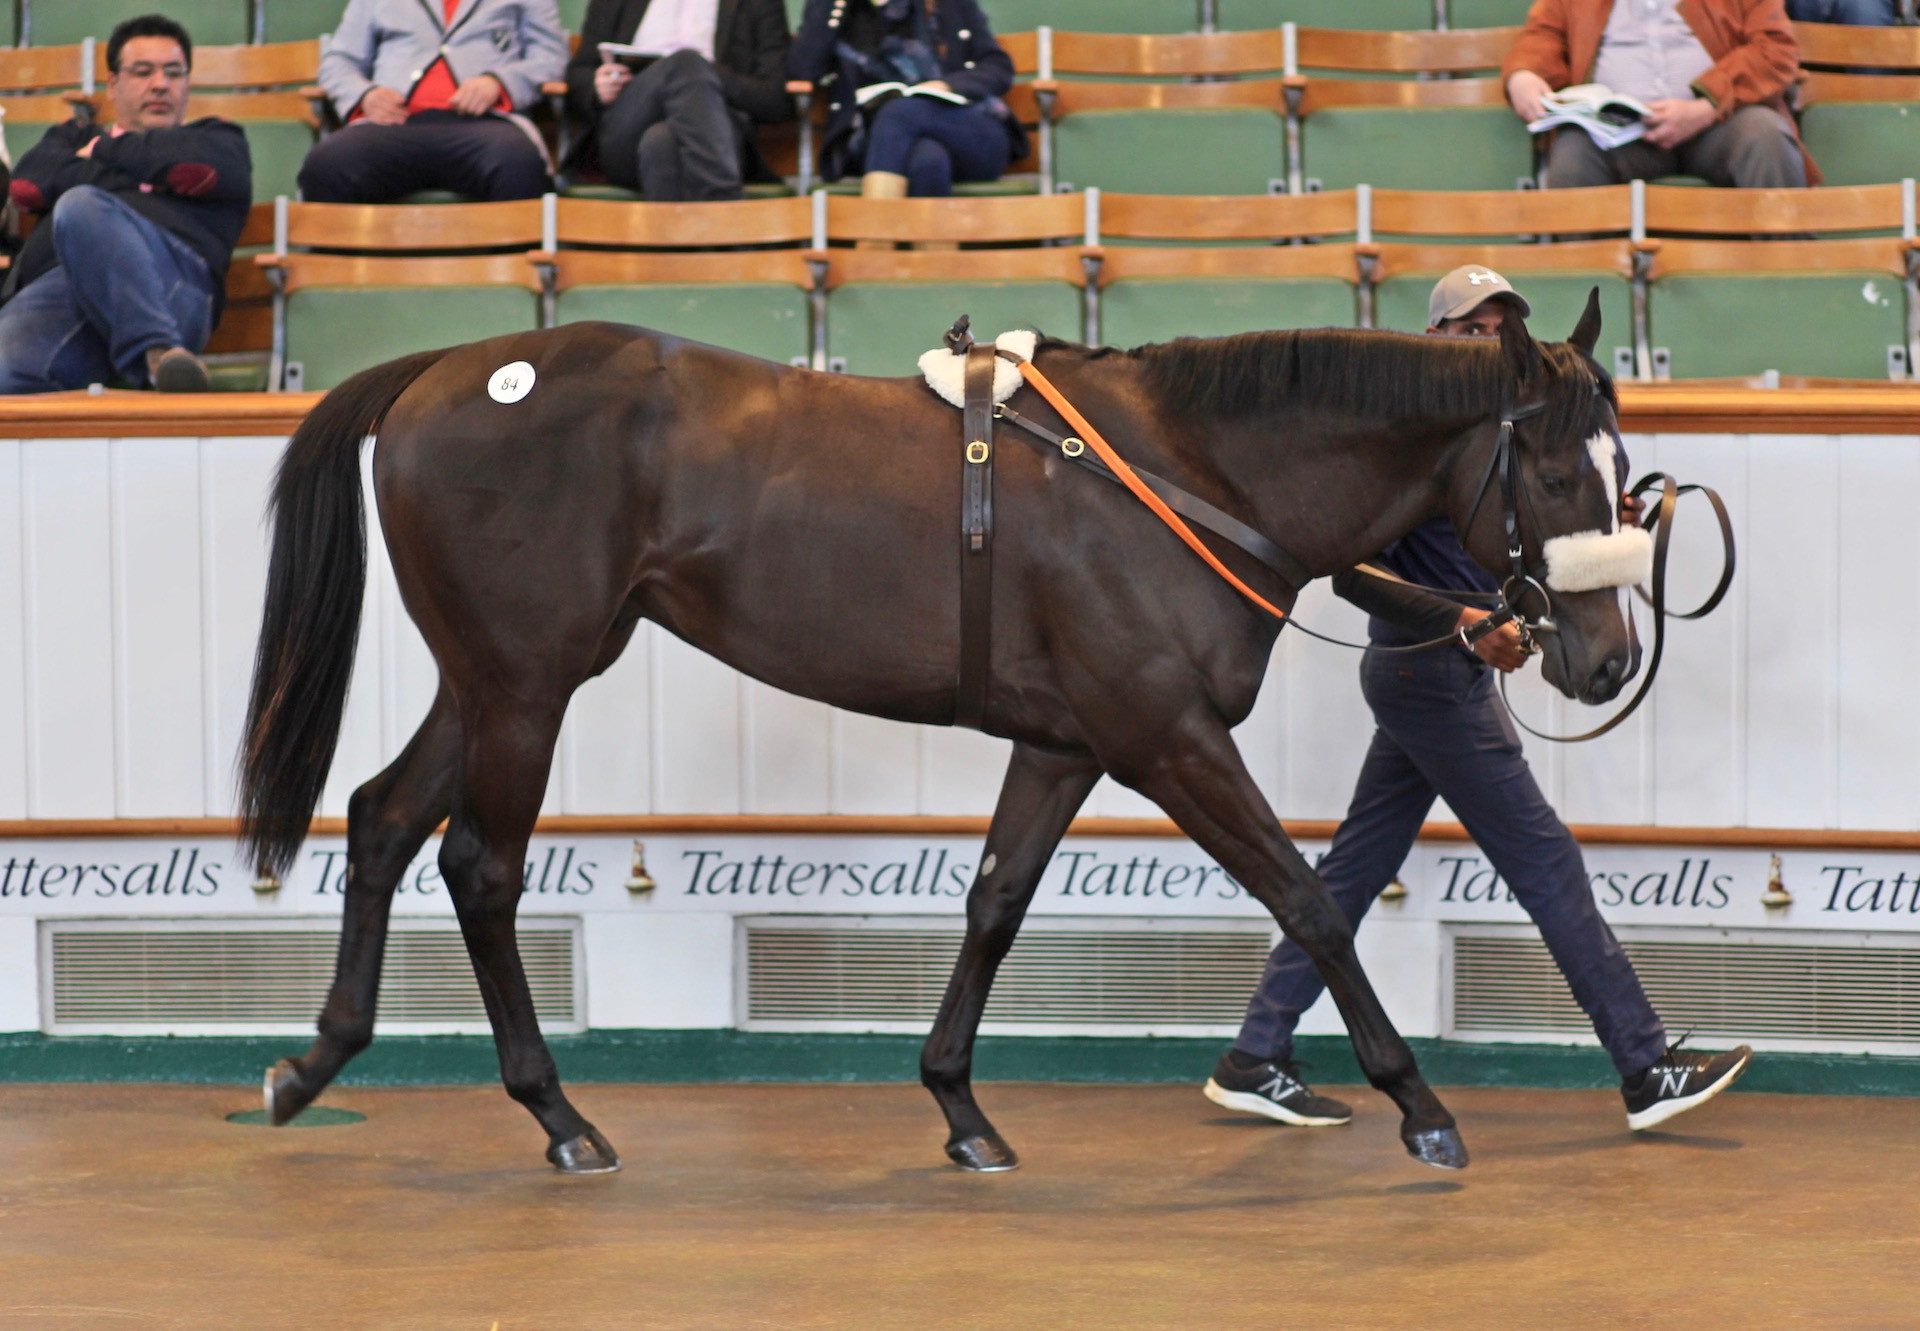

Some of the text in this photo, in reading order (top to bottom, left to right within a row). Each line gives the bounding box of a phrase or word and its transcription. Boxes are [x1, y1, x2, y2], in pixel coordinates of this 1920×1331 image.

[501, 377, 519, 391] 84
[682, 848, 970, 897] Tattersalls
[1057, 851, 1326, 899] Tatters
[1437, 856, 1734, 909] Tasalls
[1257, 1077, 1296, 1102] N
[1658, 1072, 1689, 1097] N
